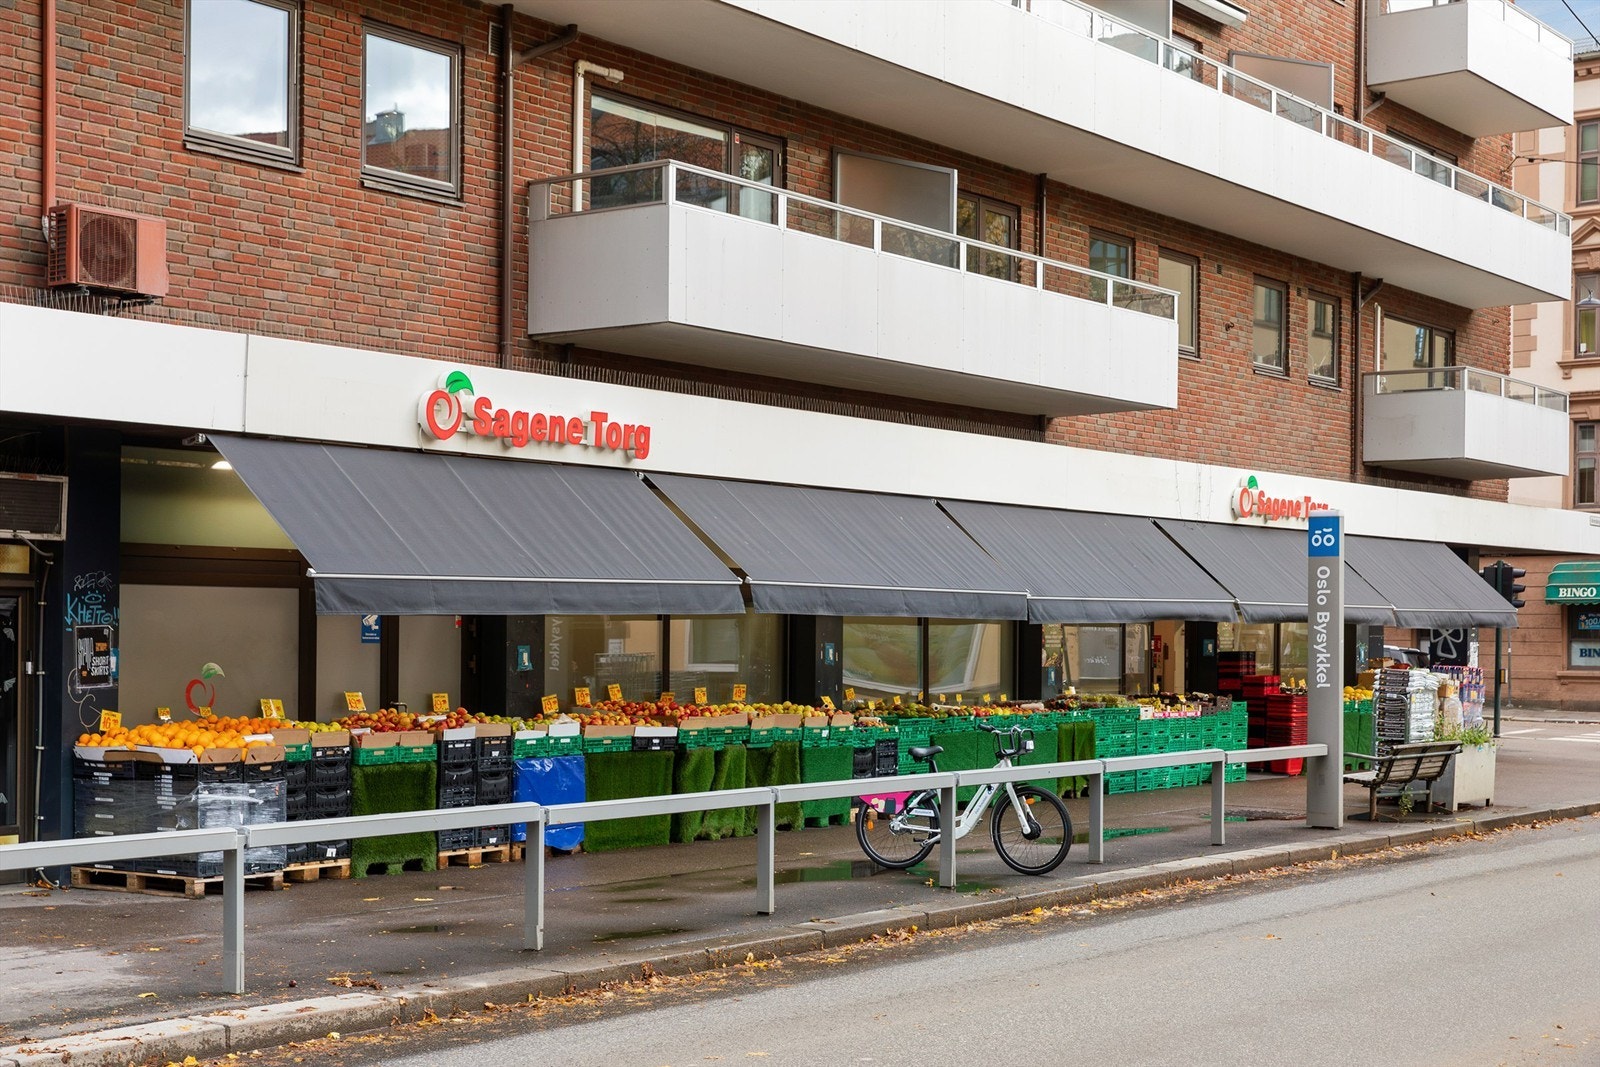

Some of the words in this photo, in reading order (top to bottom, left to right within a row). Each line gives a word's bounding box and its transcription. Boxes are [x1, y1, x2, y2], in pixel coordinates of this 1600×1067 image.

[473, 397, 584, 448] Sagene
[591, 411, 651, 459] Torg
[1257, 490, 1302, 521] Sagene
[1316, 566, 1331, 605] Oslo
[1558, 587, 1597, 598] BINGO
[1314, 612, 1331, 688] Bysykkel
